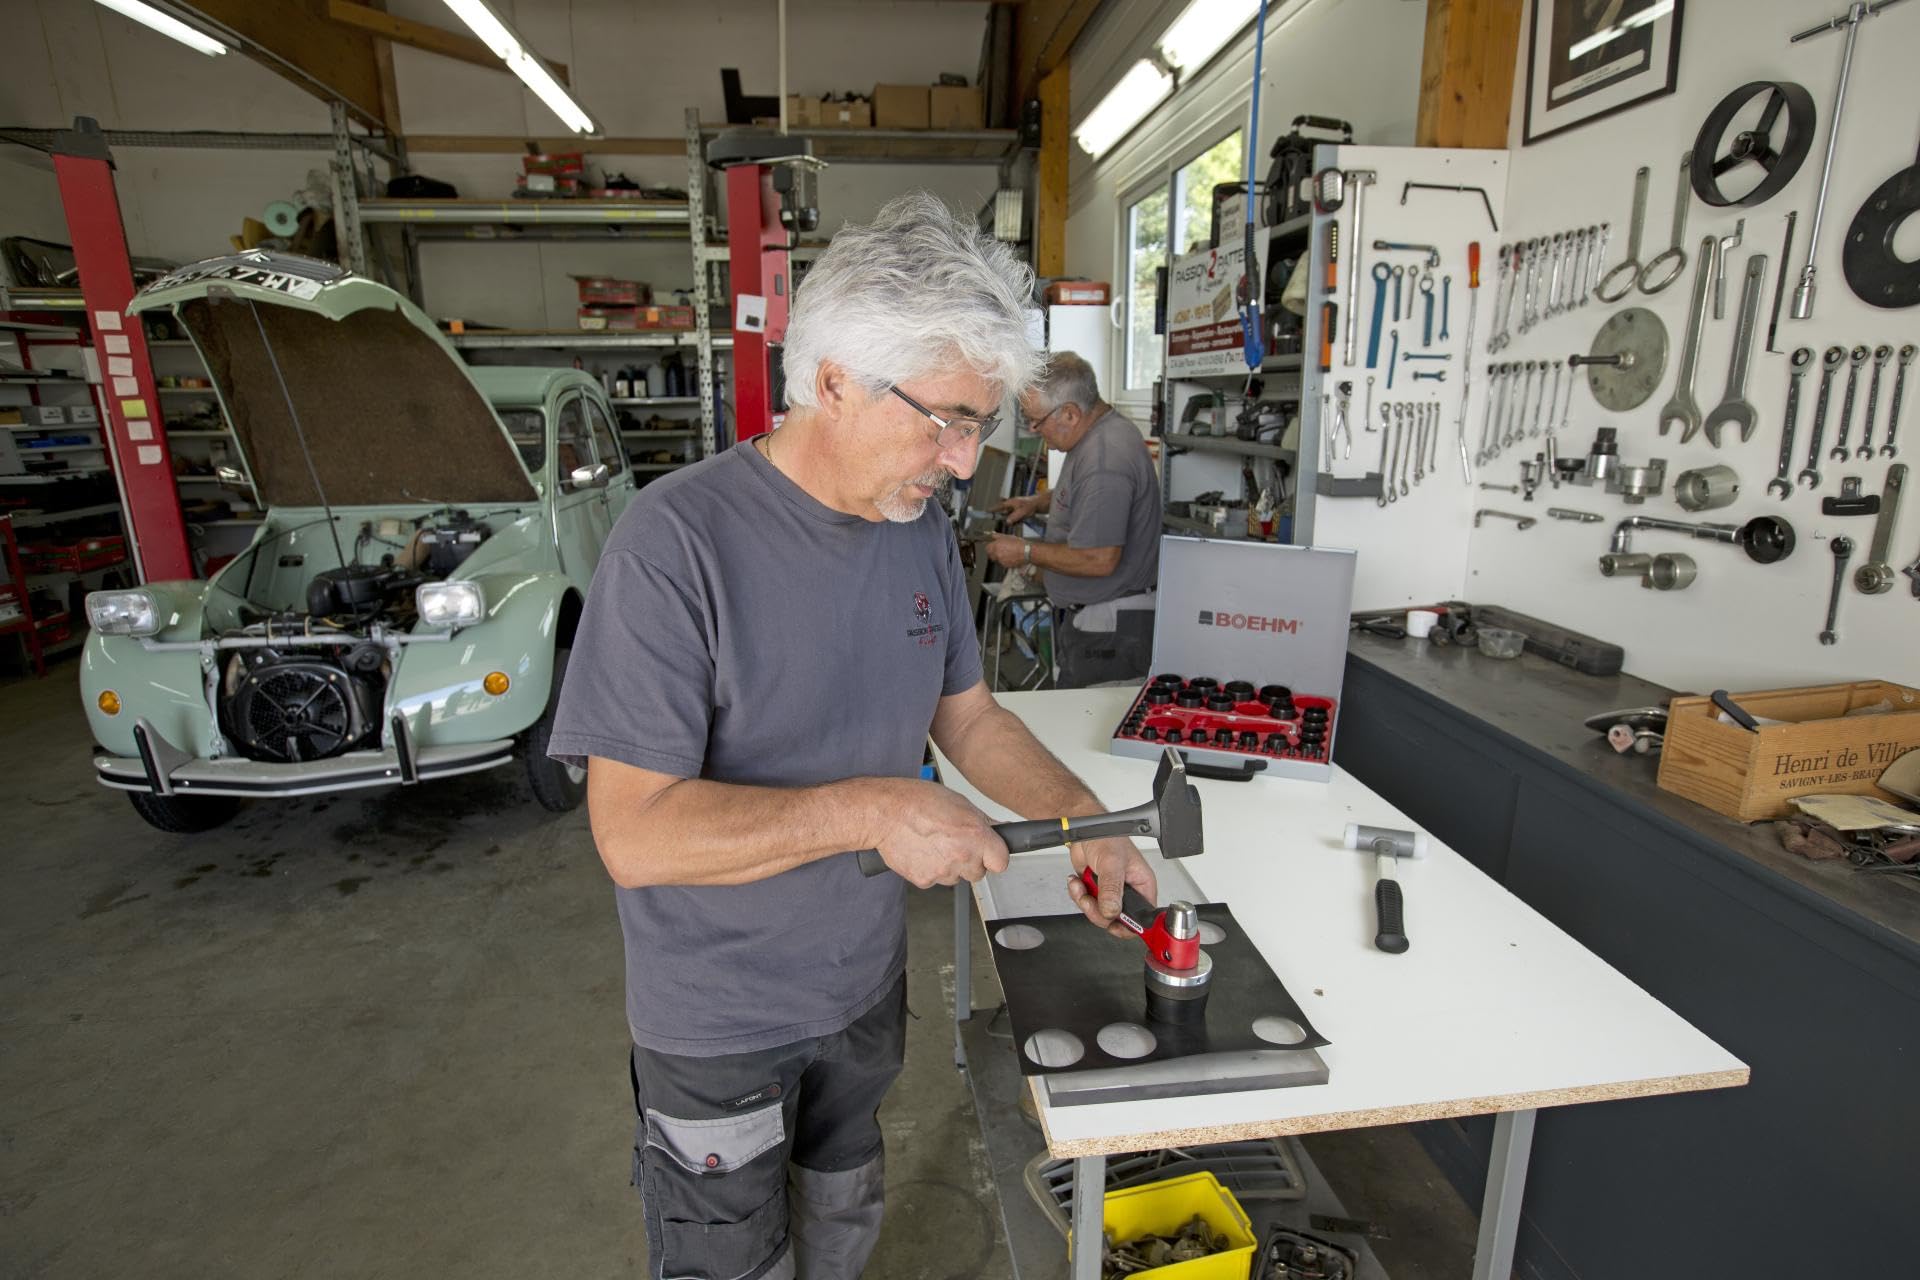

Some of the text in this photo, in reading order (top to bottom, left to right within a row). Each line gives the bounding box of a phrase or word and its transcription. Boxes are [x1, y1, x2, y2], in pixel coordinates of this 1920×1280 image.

[1216, 612, 1297, 635] BOEHM
[1773, 750, 1831, 776] Henri
[1836, 748, 1858, 768] de
[735, 1092, 762, 1106] LAFONT
